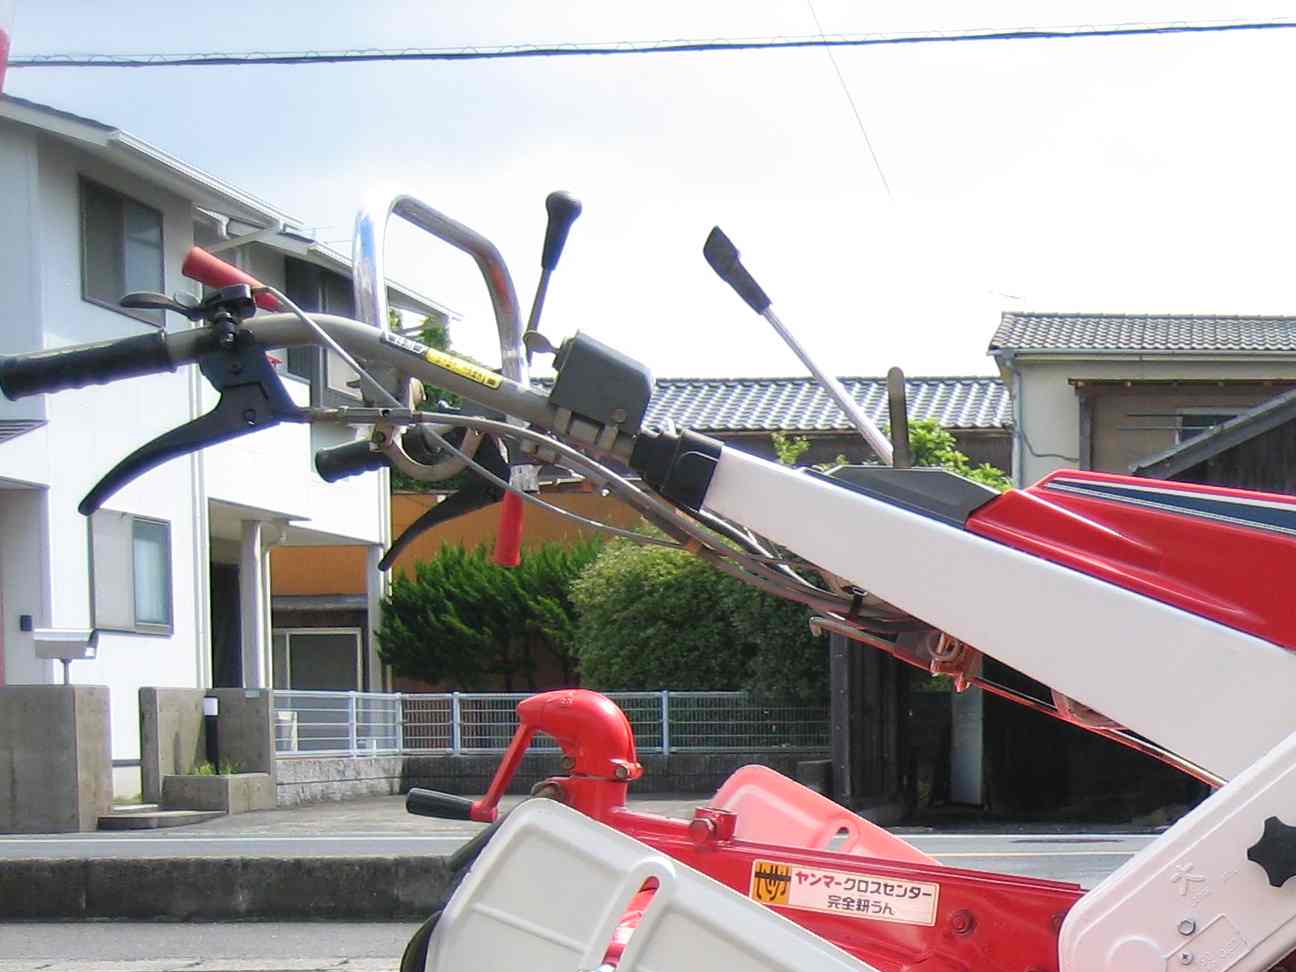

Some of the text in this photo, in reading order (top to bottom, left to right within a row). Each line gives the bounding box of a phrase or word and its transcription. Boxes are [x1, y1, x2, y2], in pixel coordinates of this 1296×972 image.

[795, 870, 932, 900] ヤンマークロスセンター
